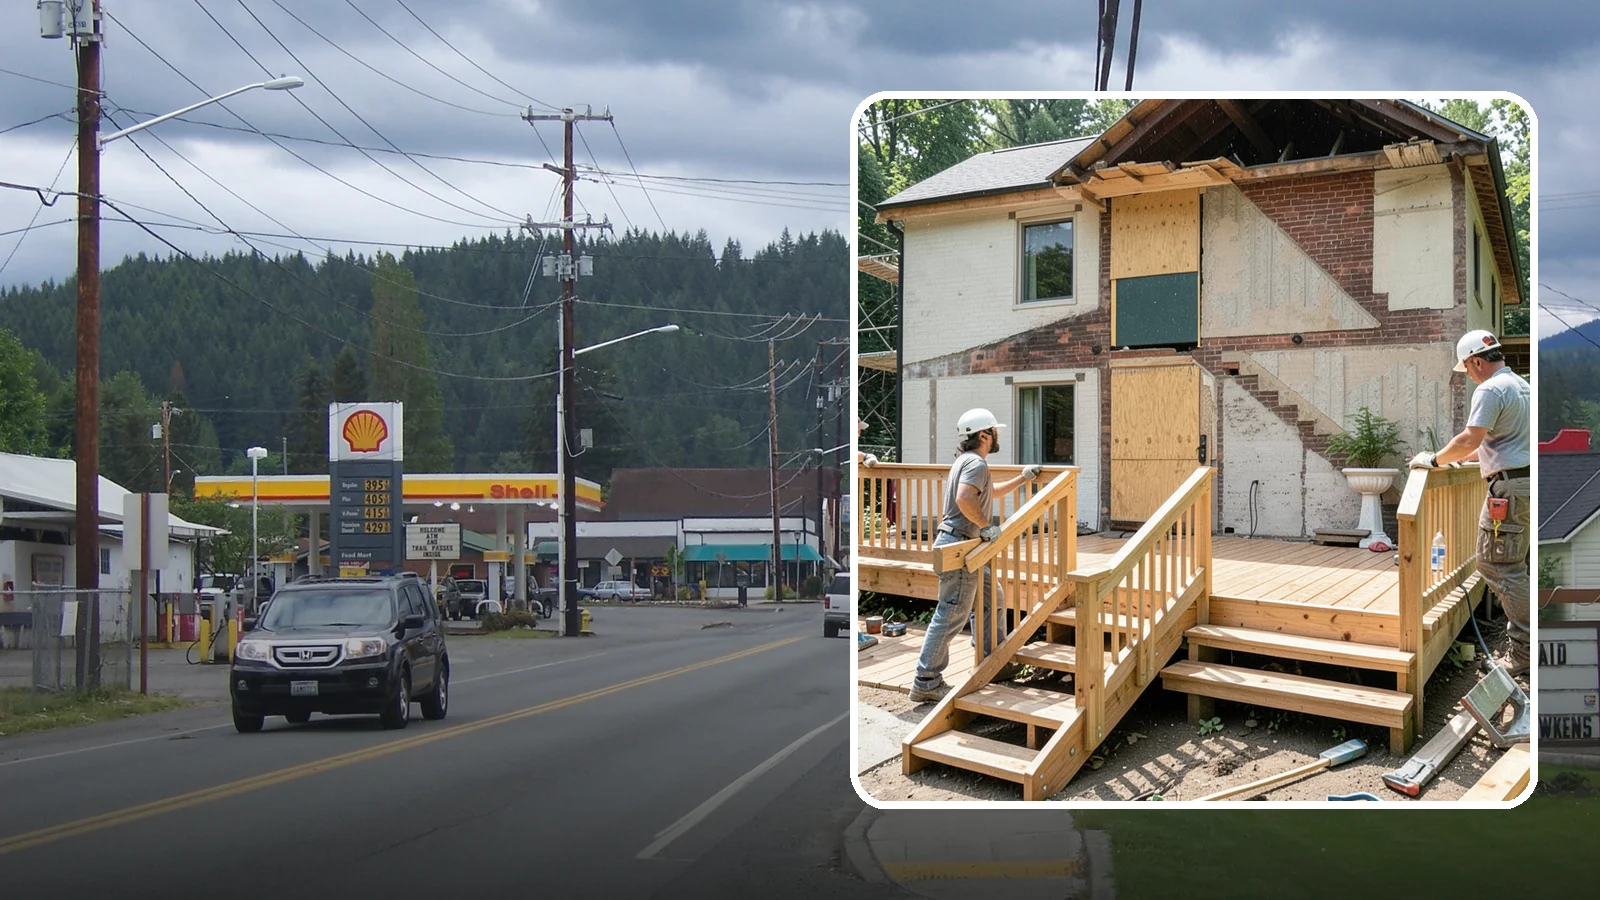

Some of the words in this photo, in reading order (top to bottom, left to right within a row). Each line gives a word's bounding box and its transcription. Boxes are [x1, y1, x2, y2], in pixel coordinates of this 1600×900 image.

[366, 480, 383, 490] 395
[490, 484, 547, 499] Shell
[366, 494, 383, 504] 405
[366, 508, 383, 518] 415
[366, 522, 383, 532] 429
[1539, 643, 1567, 665] AID
